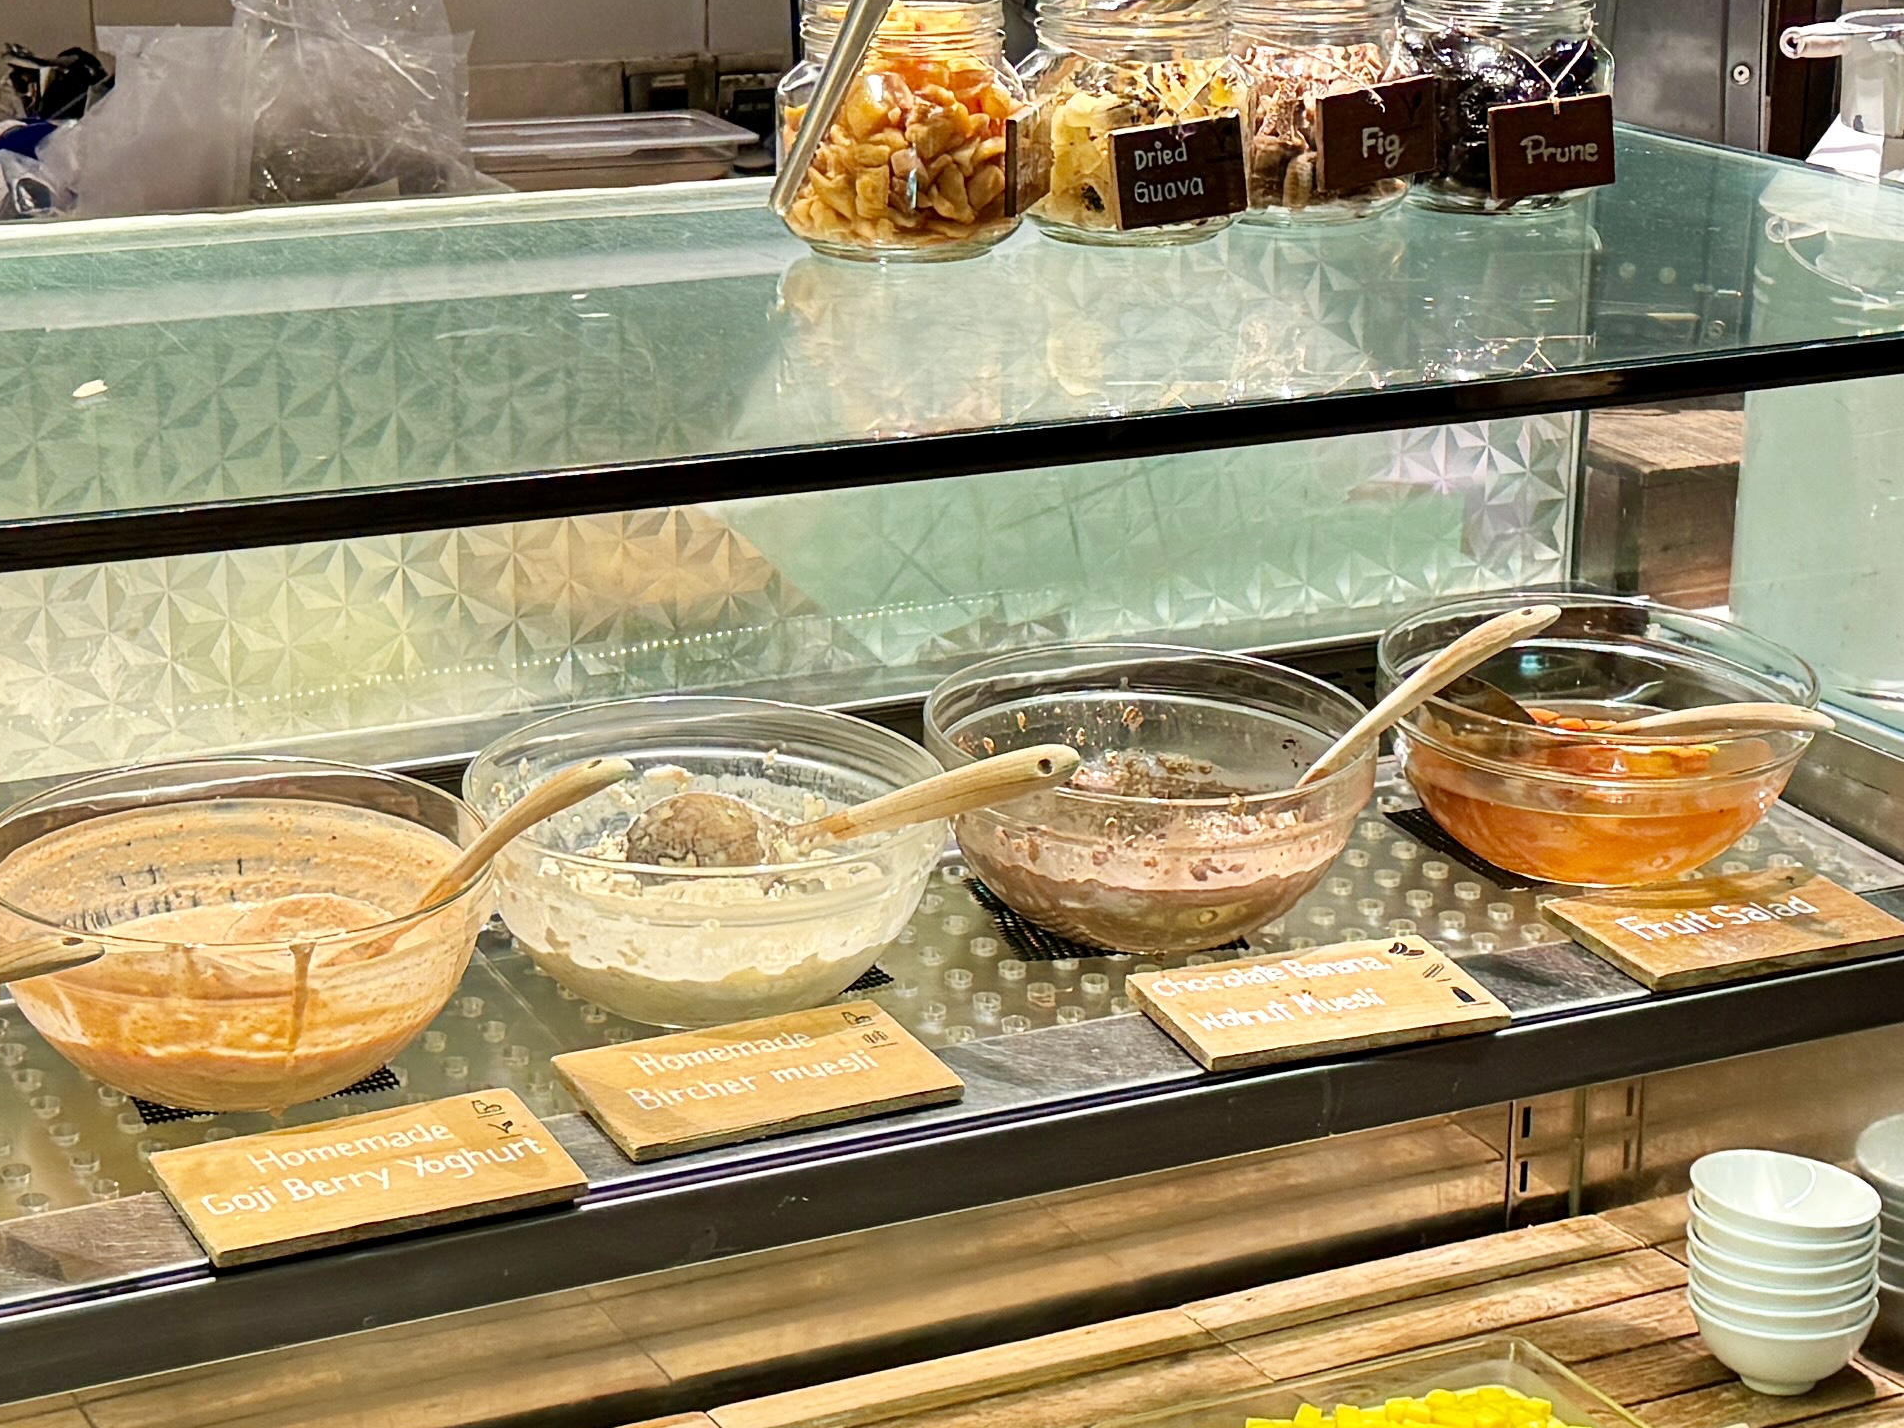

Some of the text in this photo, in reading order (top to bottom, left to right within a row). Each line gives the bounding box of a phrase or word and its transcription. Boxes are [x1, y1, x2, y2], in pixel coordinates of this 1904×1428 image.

[1133, 140, 1188, 171] Dried
[1361, 126, 1405, 170] Fig
[1519, 134, 1599, 165] Prune
[1133, 176, 1205, 204] Guava
[1614, 893, 1820, 941] Fruit Salad
[1151, 965, 1289, 998] Chocolate
[1187, 987, 1386, 1032] Walnut Muesli
[629, 1029, 818, 1079] Homemade
[625, 1074, 769, 1113] Bircher
[247, 1120, 455, 1175] Homemade
[200, 1135, 548, 1217] Goji Berry Yoghurt
